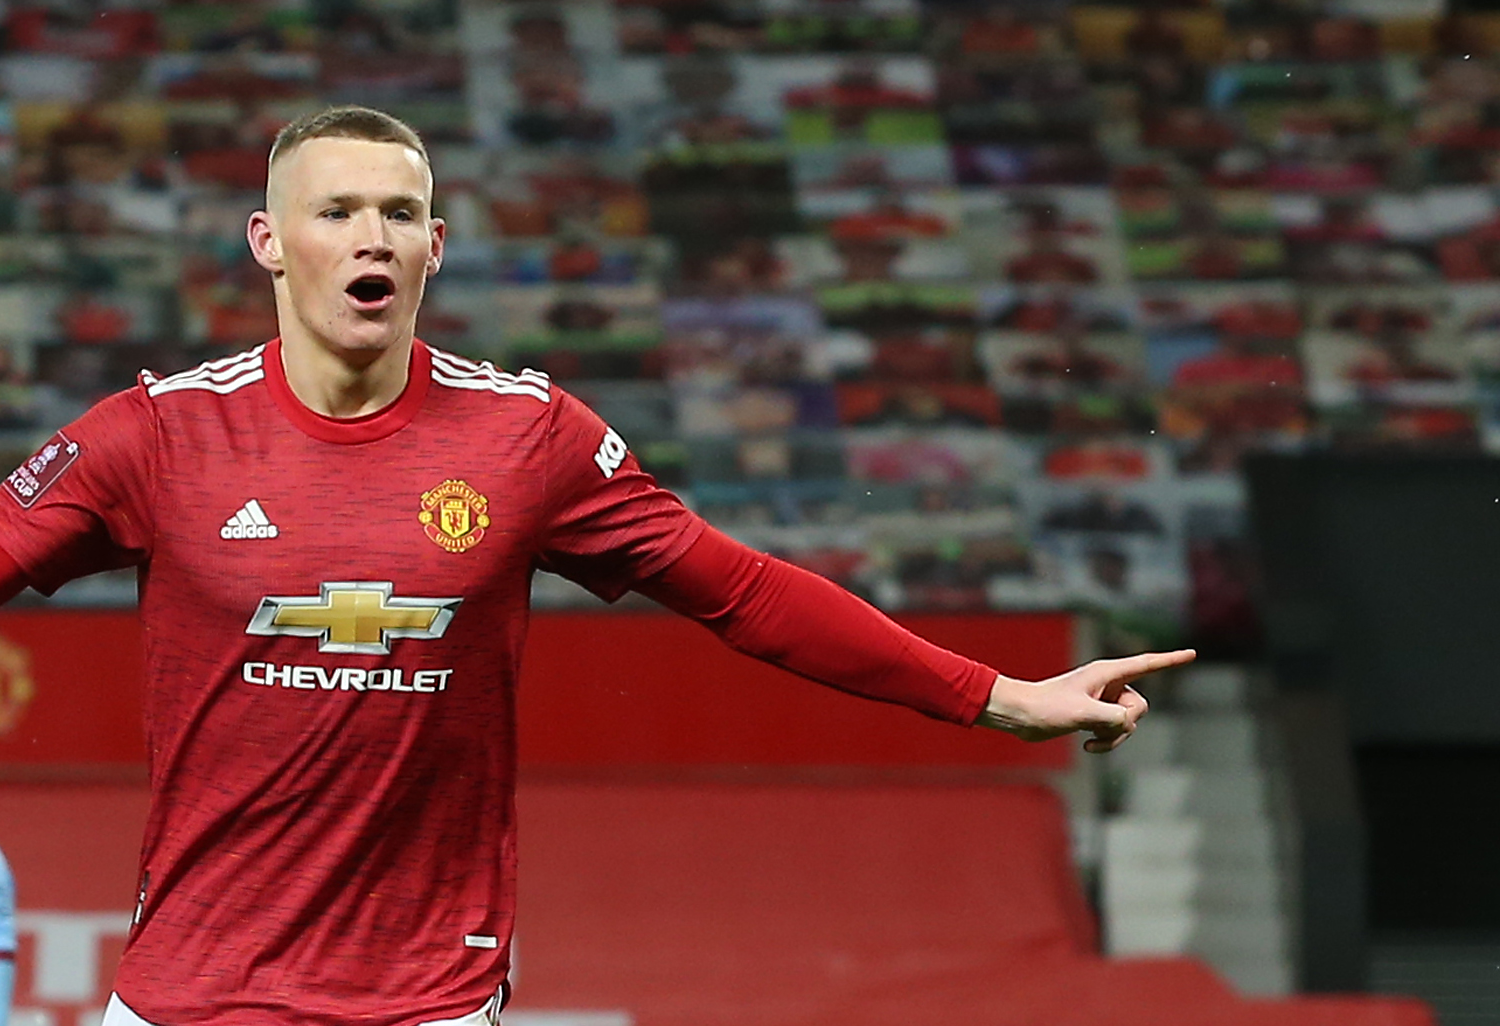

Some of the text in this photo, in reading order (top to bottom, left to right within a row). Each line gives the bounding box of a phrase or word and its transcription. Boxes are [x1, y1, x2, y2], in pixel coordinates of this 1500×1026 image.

[14, 478, 34, 497] CUP
[220, 524, 279, 540] adidas
[435, 533, 475, 547] UNITED
[243, 661, 454, 693] CHEVROLET
